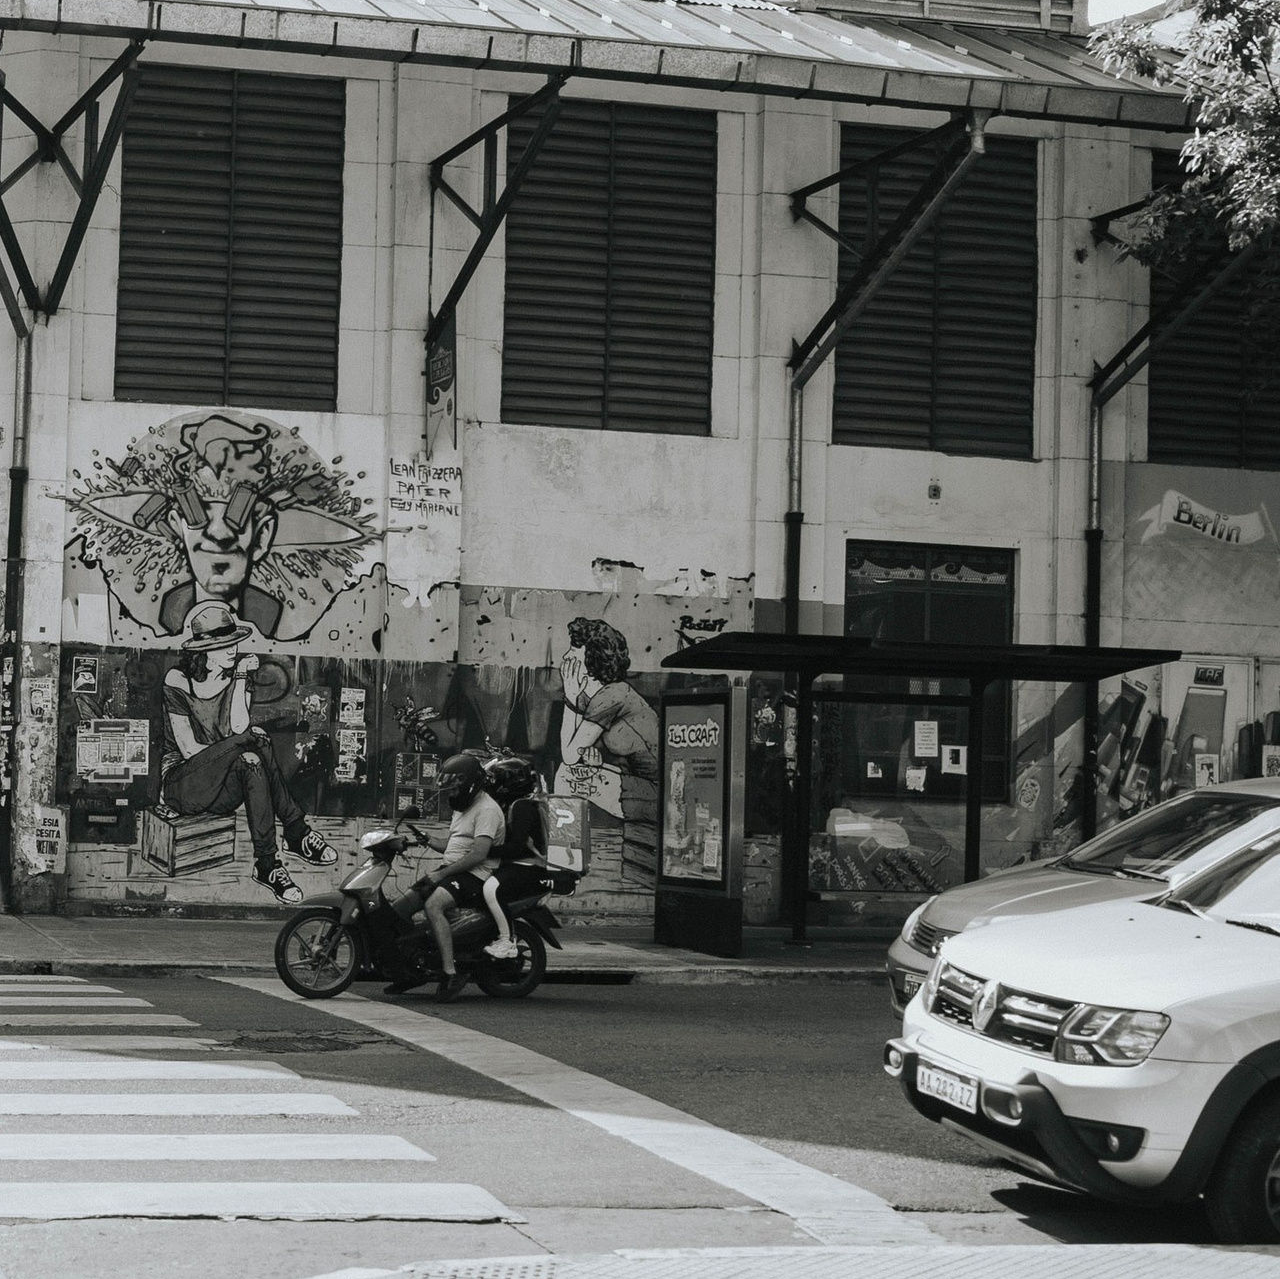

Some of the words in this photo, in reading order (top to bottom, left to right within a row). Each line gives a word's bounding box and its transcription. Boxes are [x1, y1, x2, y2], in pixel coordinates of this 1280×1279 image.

[390, 457, 416, 478] LEAN
[1173, 496, 1242, 544] Berlin
[688, 726, 719, 744] CRAFT
[920, 1070, 932, 1091] AA
[935, 1076, 955, 1102] 282
[959, 1085, 974, 1109] IZ
